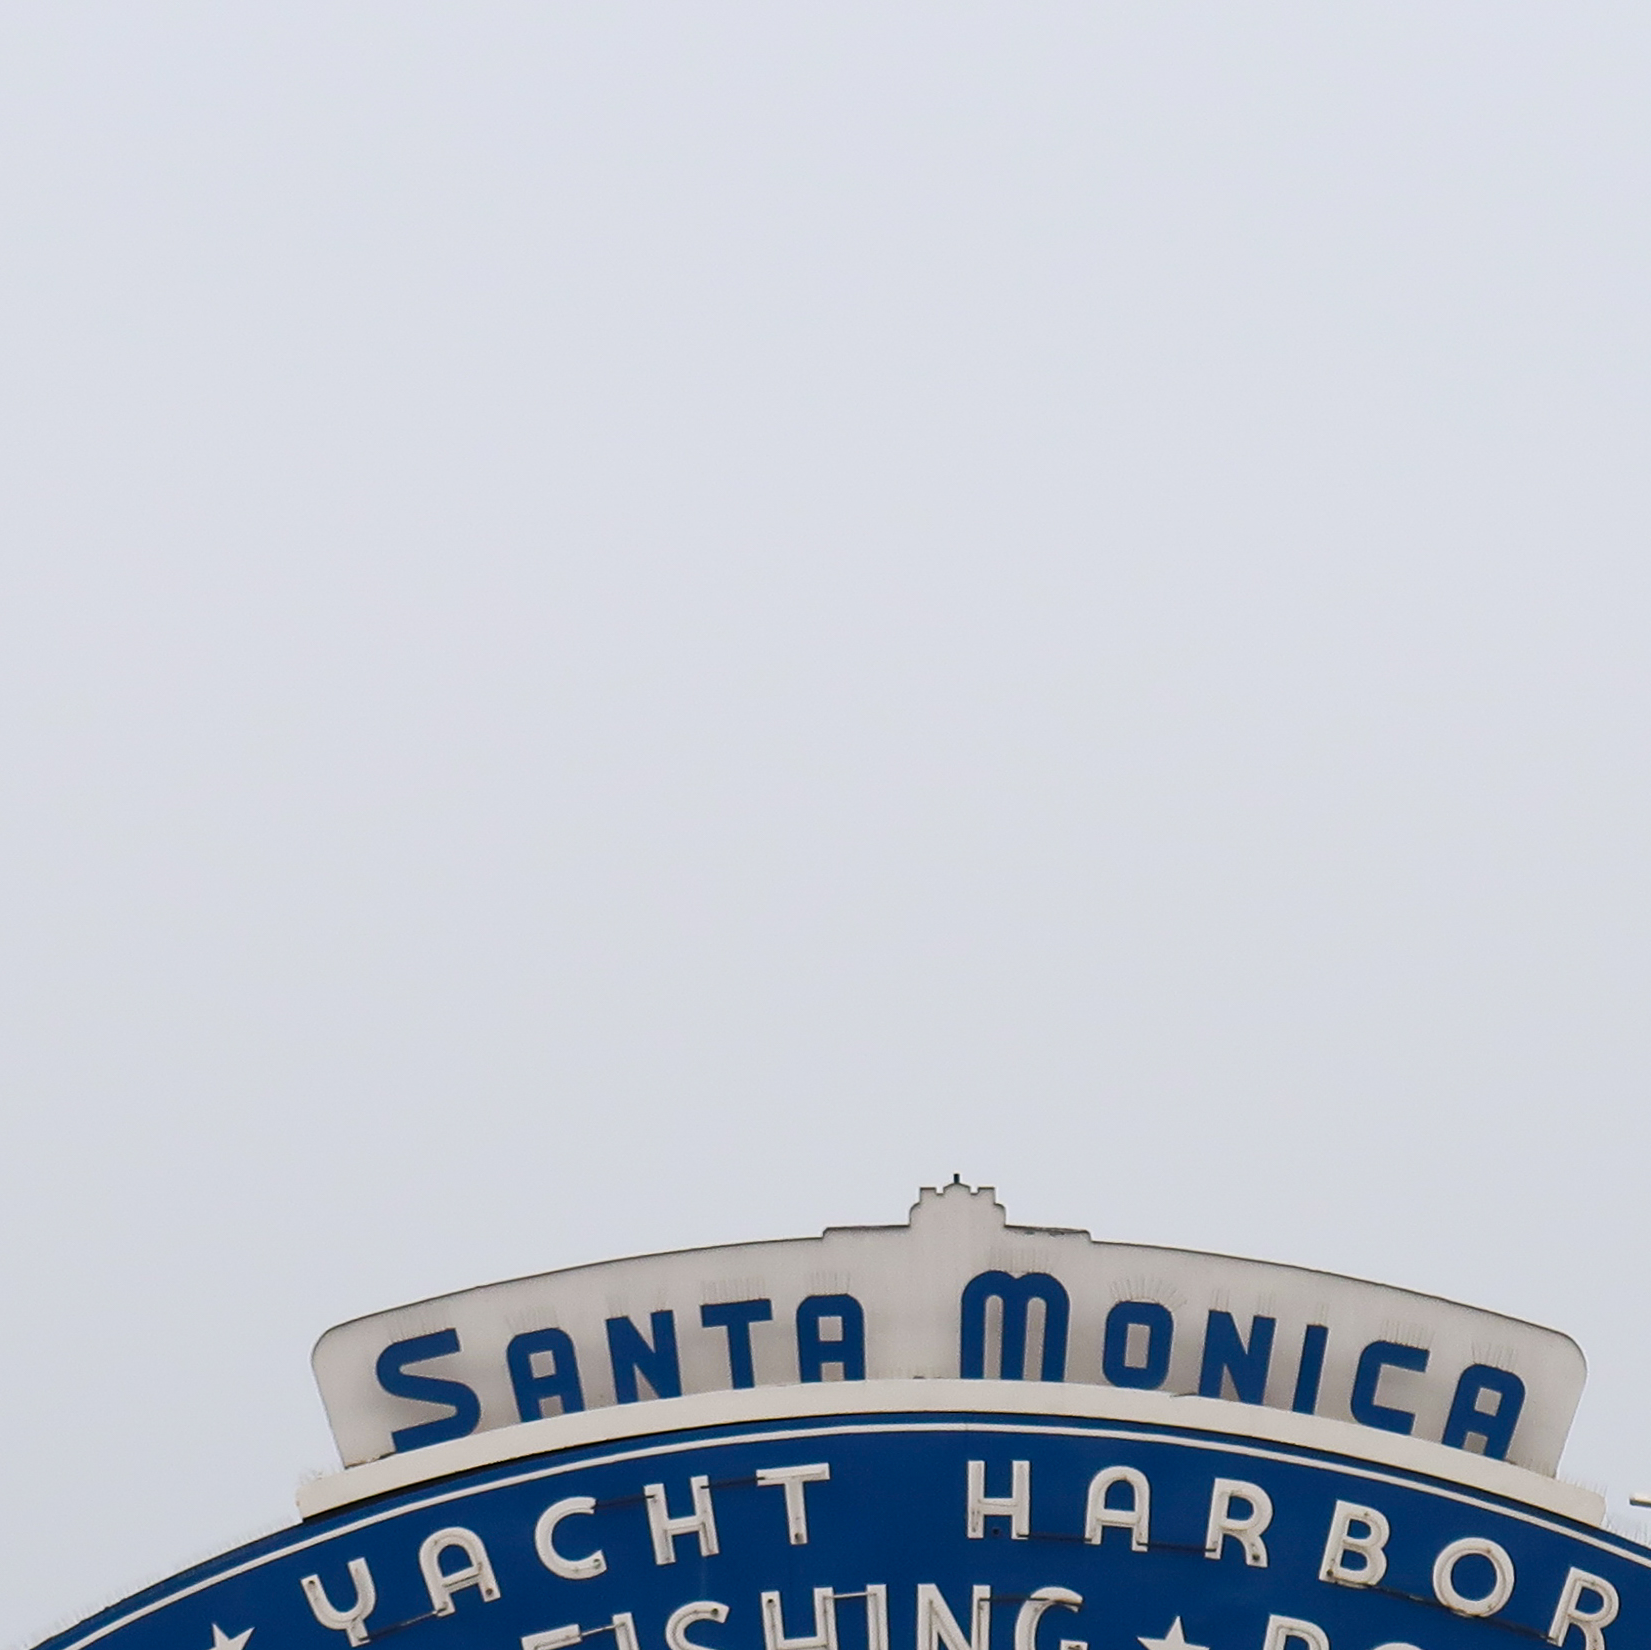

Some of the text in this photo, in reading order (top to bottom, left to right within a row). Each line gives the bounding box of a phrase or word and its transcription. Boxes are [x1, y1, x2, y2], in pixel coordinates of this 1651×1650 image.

[375, 1269, 1525, 1455] SANTA MONICA
[301, 1462, 834, 1646] YACHT
